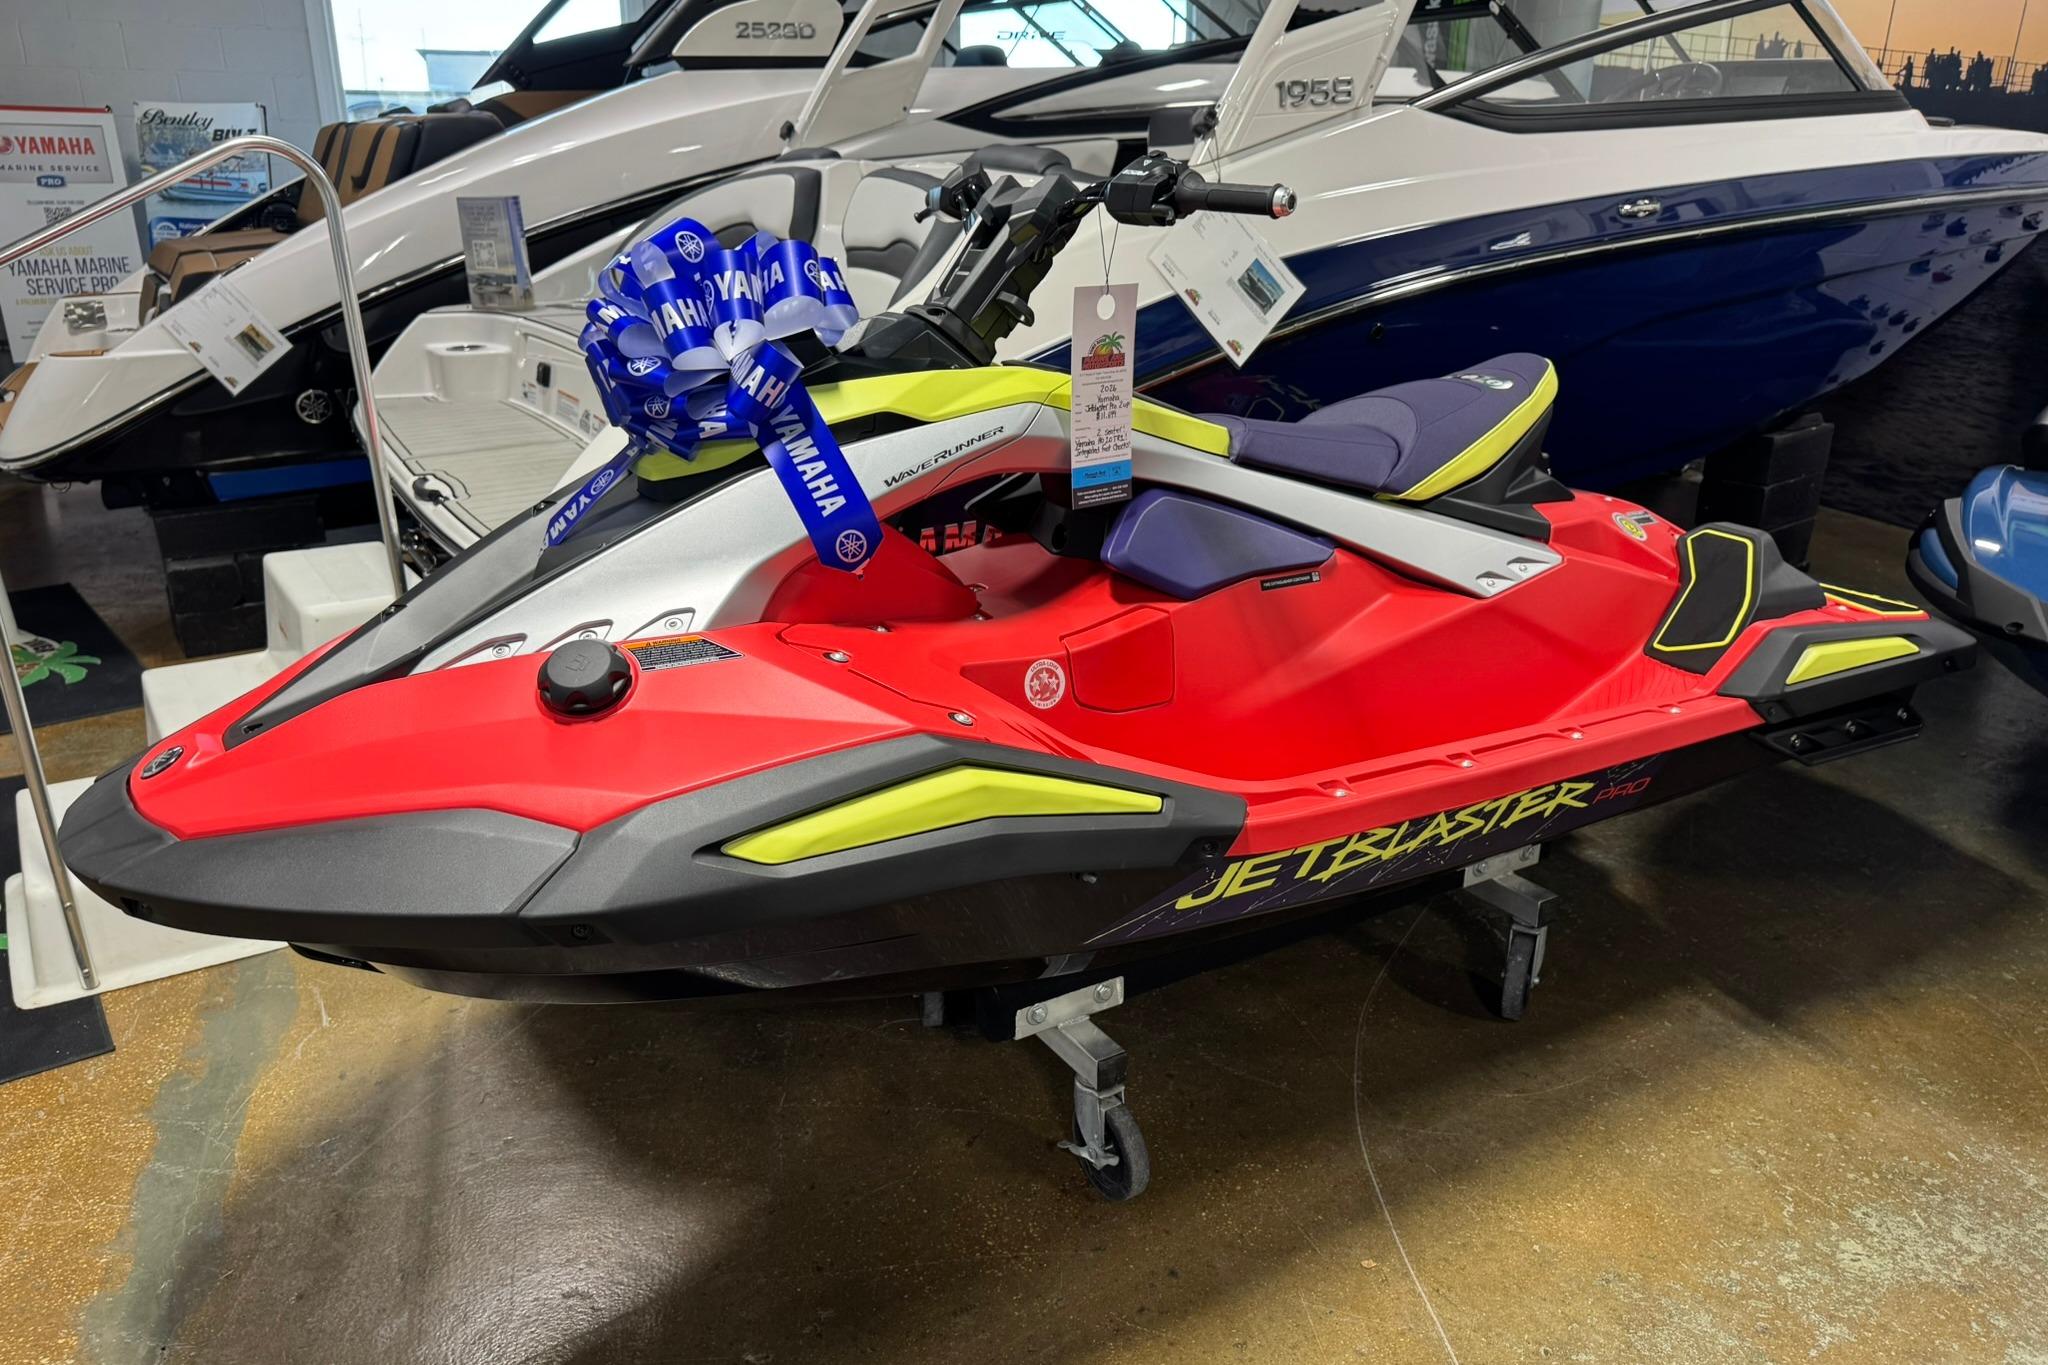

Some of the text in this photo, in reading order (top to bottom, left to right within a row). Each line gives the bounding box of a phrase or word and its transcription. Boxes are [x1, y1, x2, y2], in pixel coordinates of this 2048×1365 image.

[141, 108, 214, 130] Bentley
[14, 136, 96, 155] YAMAHA
[50, 164, 100, 172] SERVICE
[40, 178, 62, 186] PRO
[8, 256, 132, 277] YAMAHA MARINE
[26, 277, 87, 296] SERVICE
[1100, 384, 1117, 393] 2026
[769, 404, 847, 518] YAMAHA
[1175, 777, 1652, 910] JETBLASTER PRO
